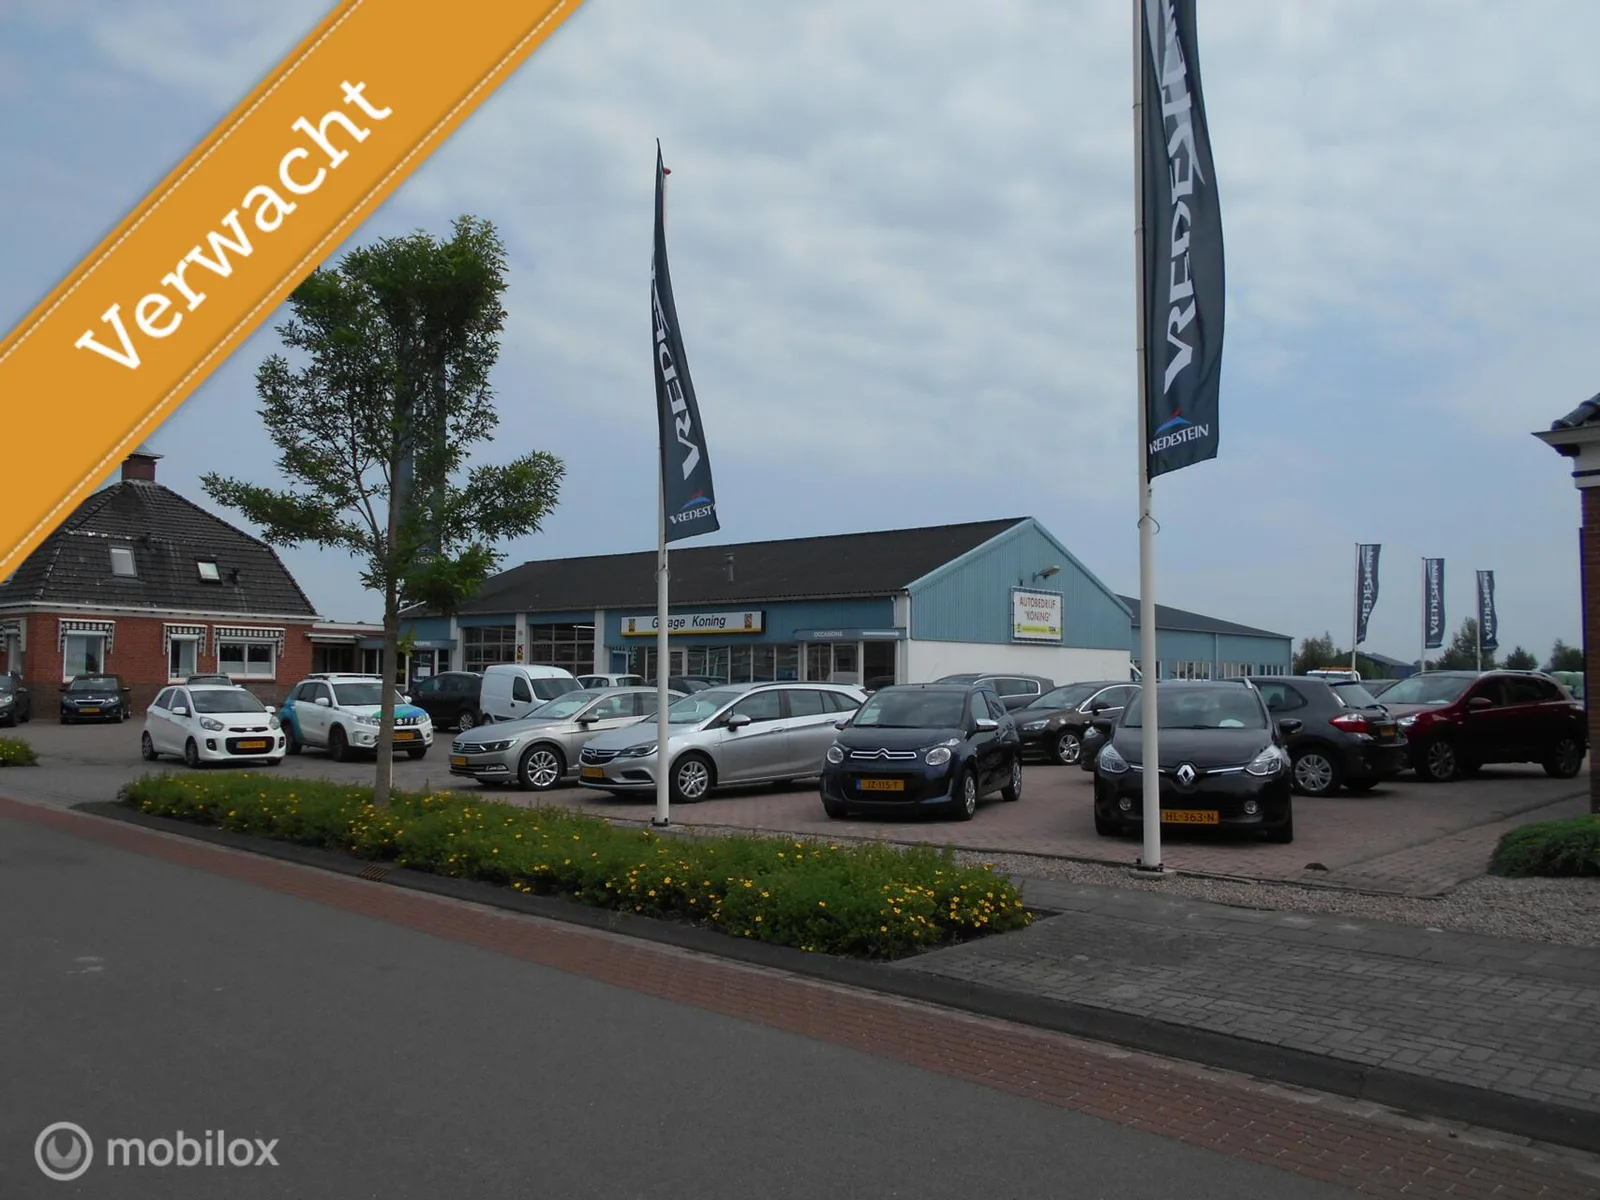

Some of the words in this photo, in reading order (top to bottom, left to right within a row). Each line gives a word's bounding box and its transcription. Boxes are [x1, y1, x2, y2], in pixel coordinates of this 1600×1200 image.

[669, 504, 716, 524] VREDEST
[1020, 596, 1056, 609] AUTOBEDRIJF
[652, 617, 685, 629] Gage
[692, 615, 726, 628] Koning
